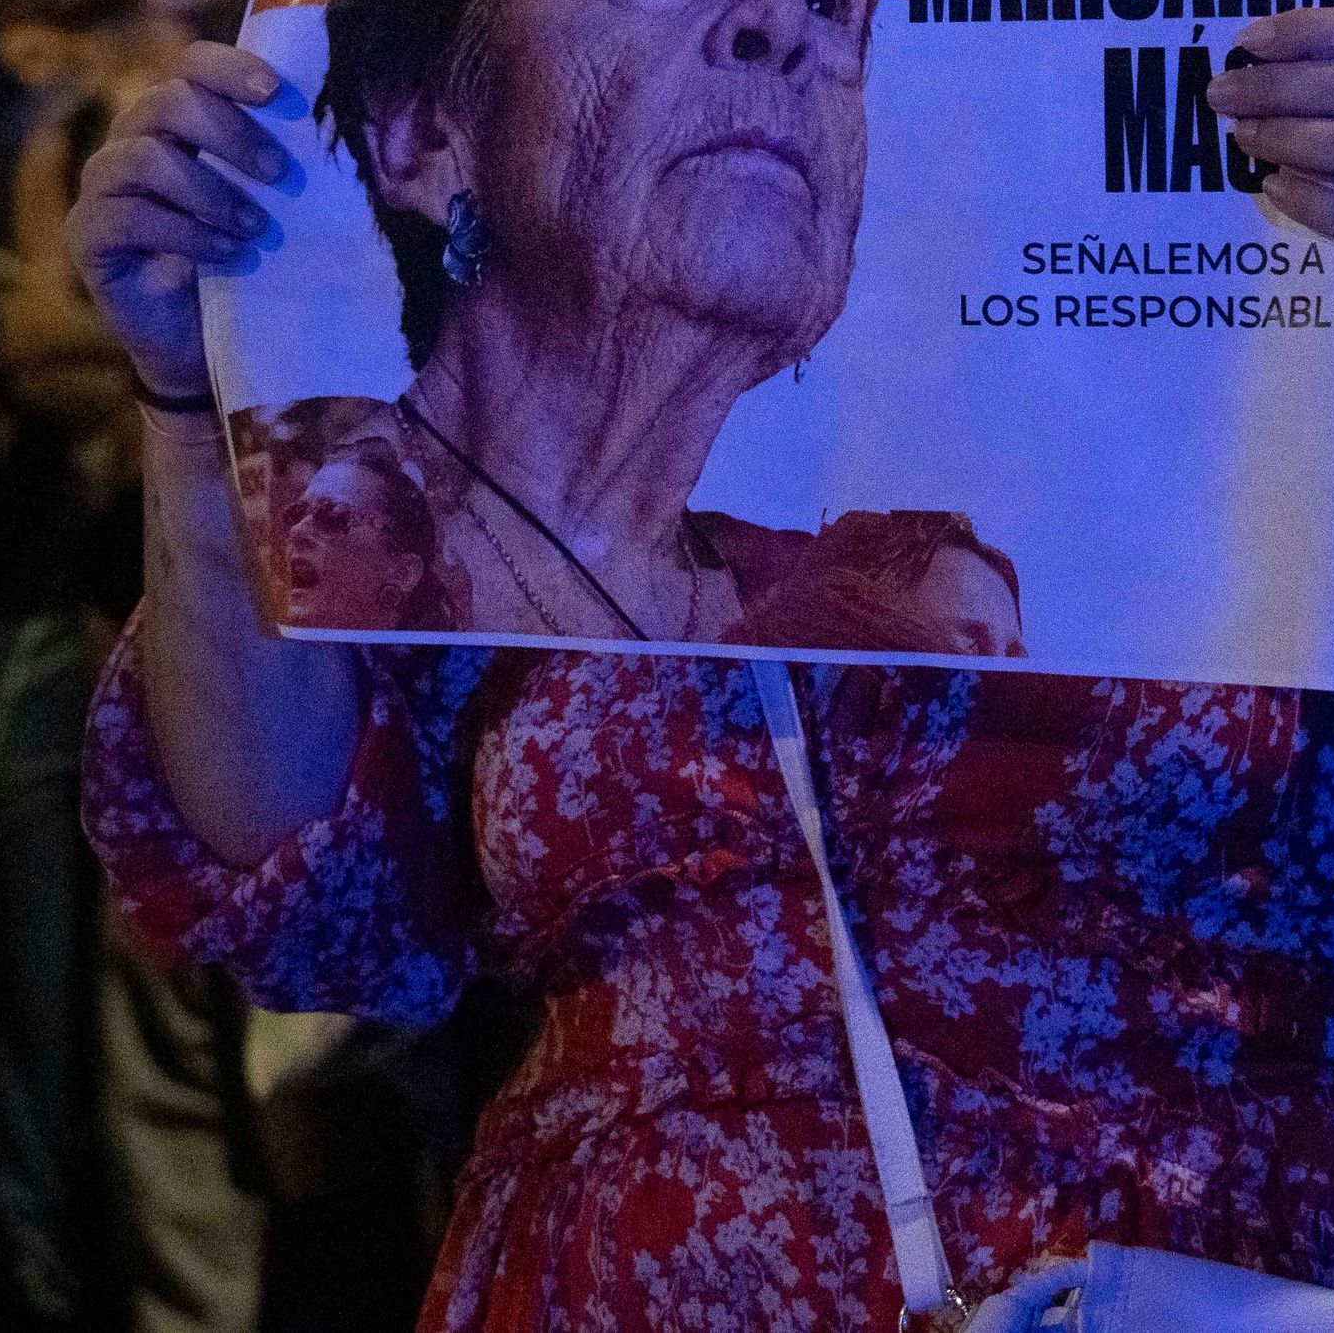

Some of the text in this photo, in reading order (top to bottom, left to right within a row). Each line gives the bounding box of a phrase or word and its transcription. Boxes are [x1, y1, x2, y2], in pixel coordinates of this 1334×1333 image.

[1021, 234, 1325, 276] SEÑALEMOS A
[960, 294, 1040, 328] LOS
